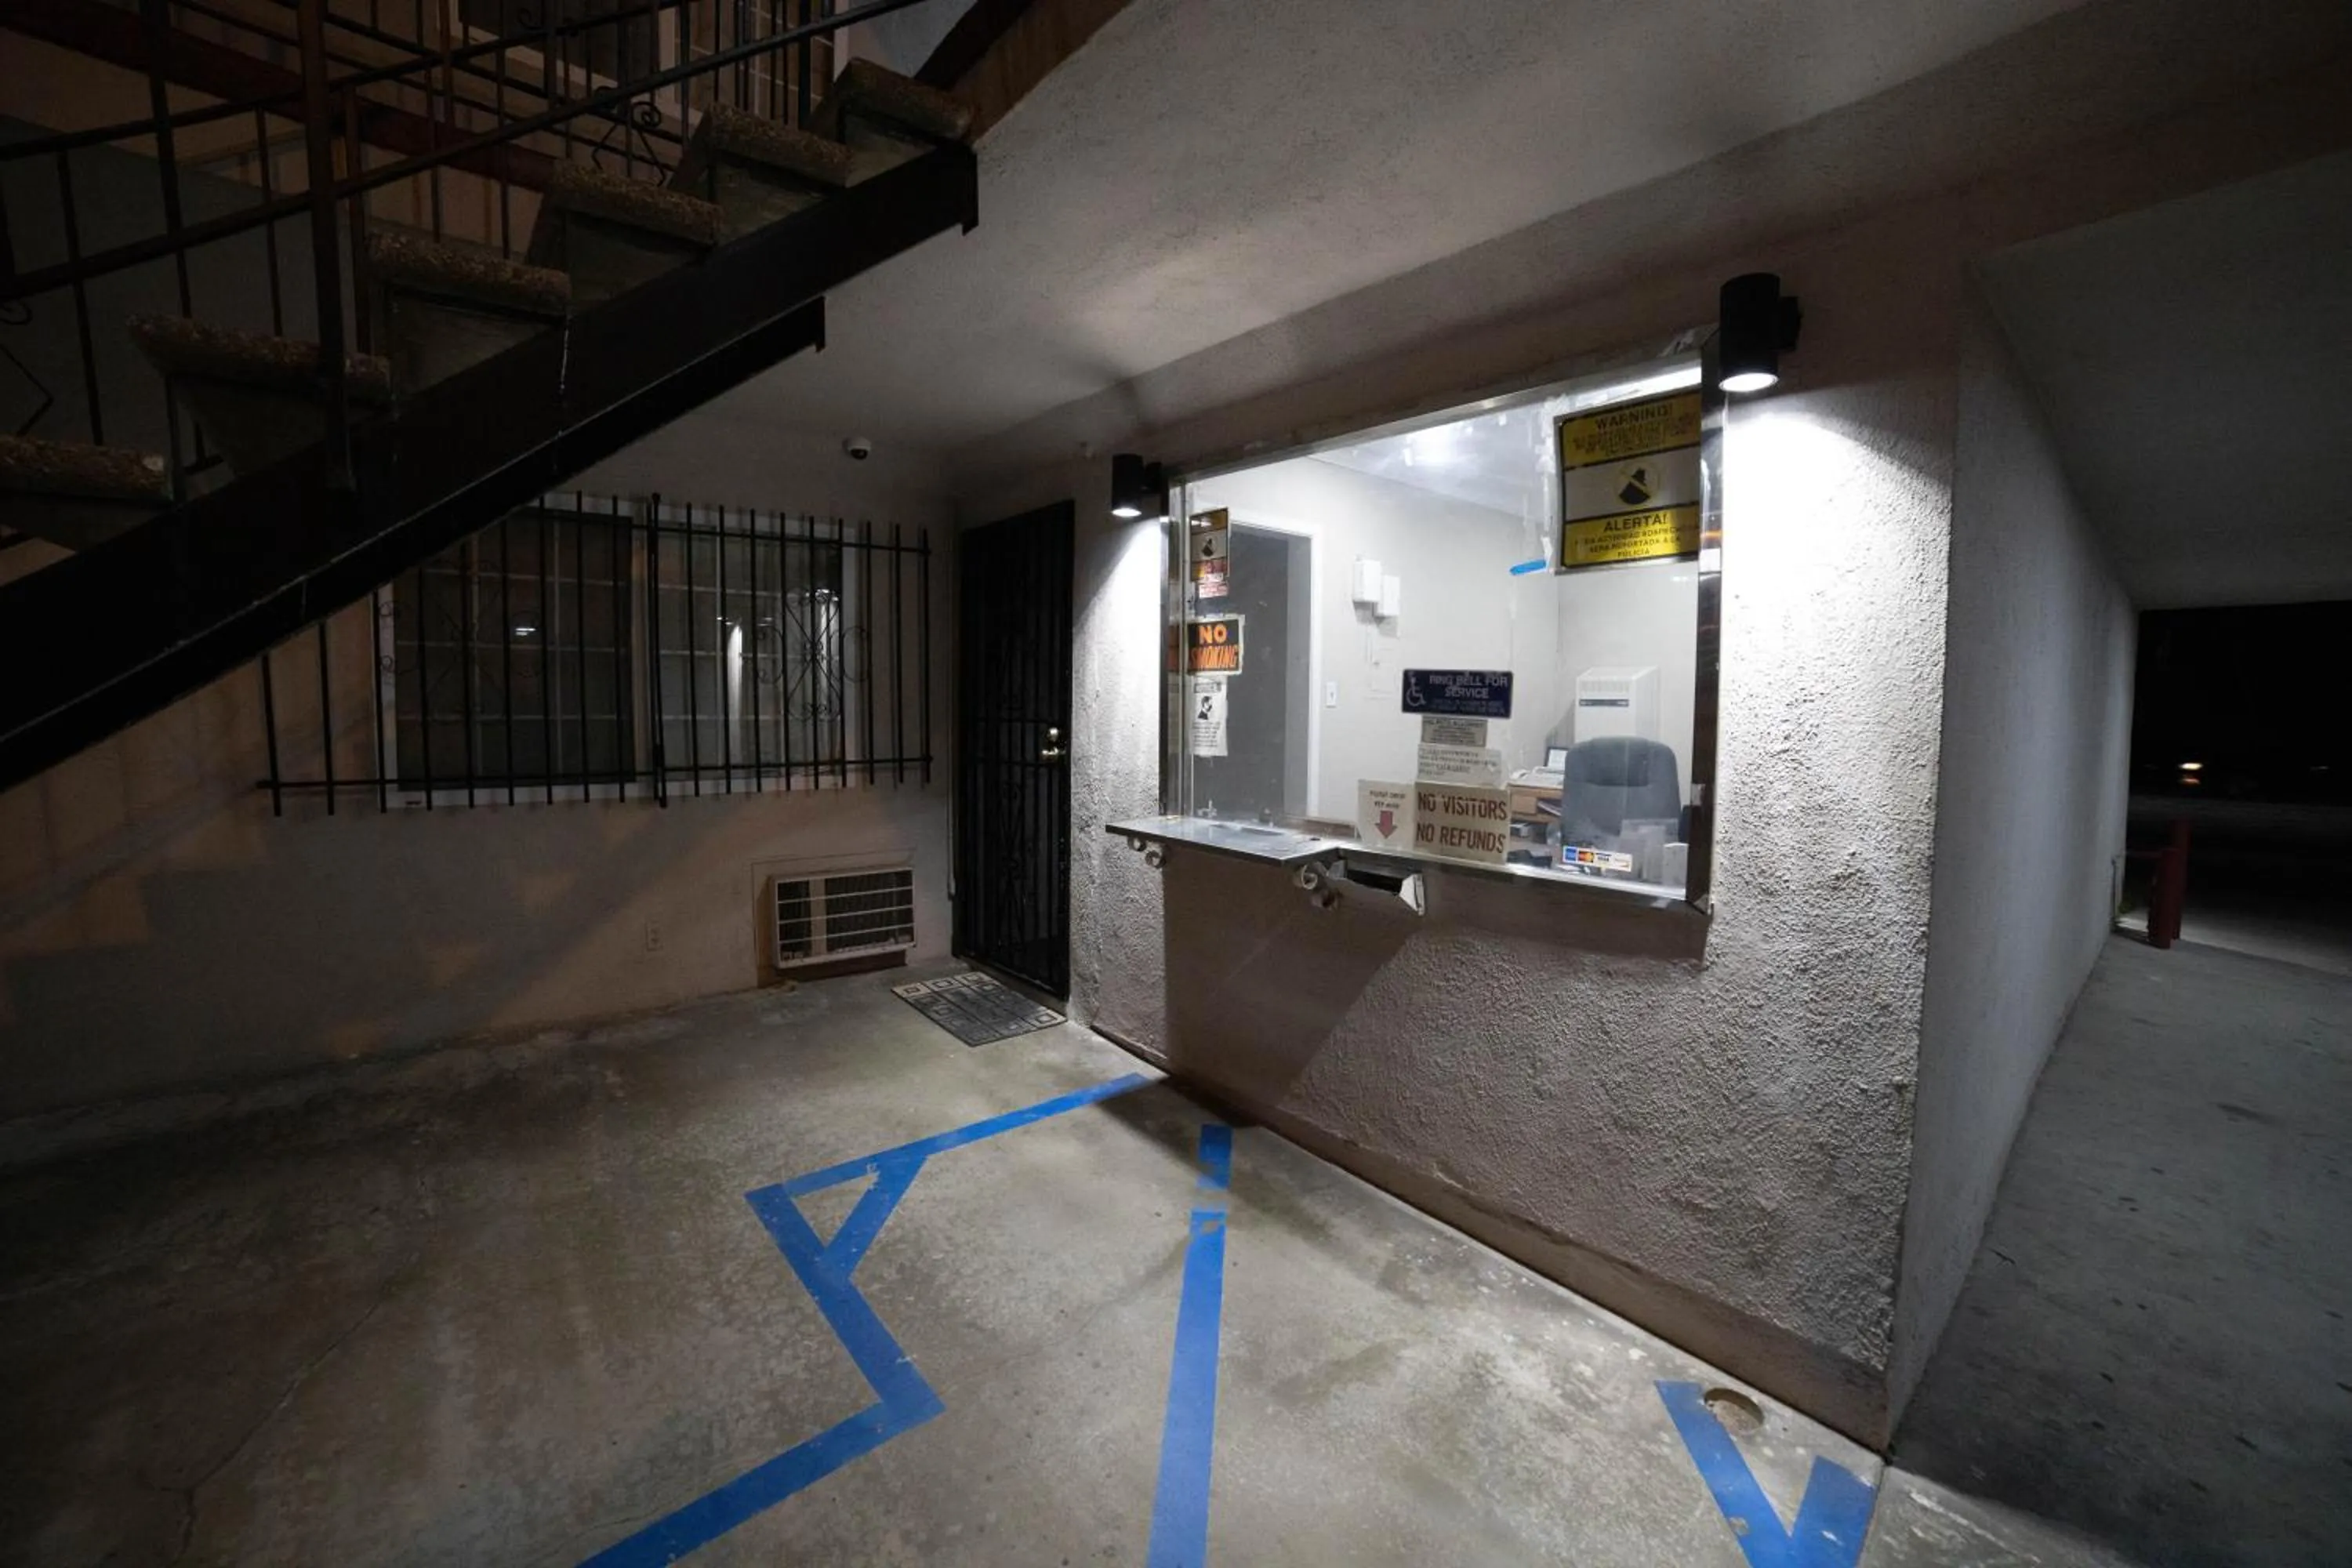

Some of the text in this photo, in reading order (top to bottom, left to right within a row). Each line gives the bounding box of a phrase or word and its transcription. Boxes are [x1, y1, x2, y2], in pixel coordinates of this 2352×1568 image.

[1603, 514, 1668, 532] ALERTA!
[1198, 622, 1228, 644] NO
[1429, 675, 1508, 688] RING BELL FOR
[1444, 686, 1490, 699] SERVICE
[1417, 792, 1508, 821] NO VISITORS
[1416, 822, 1507, 854] NO REFUNDS
